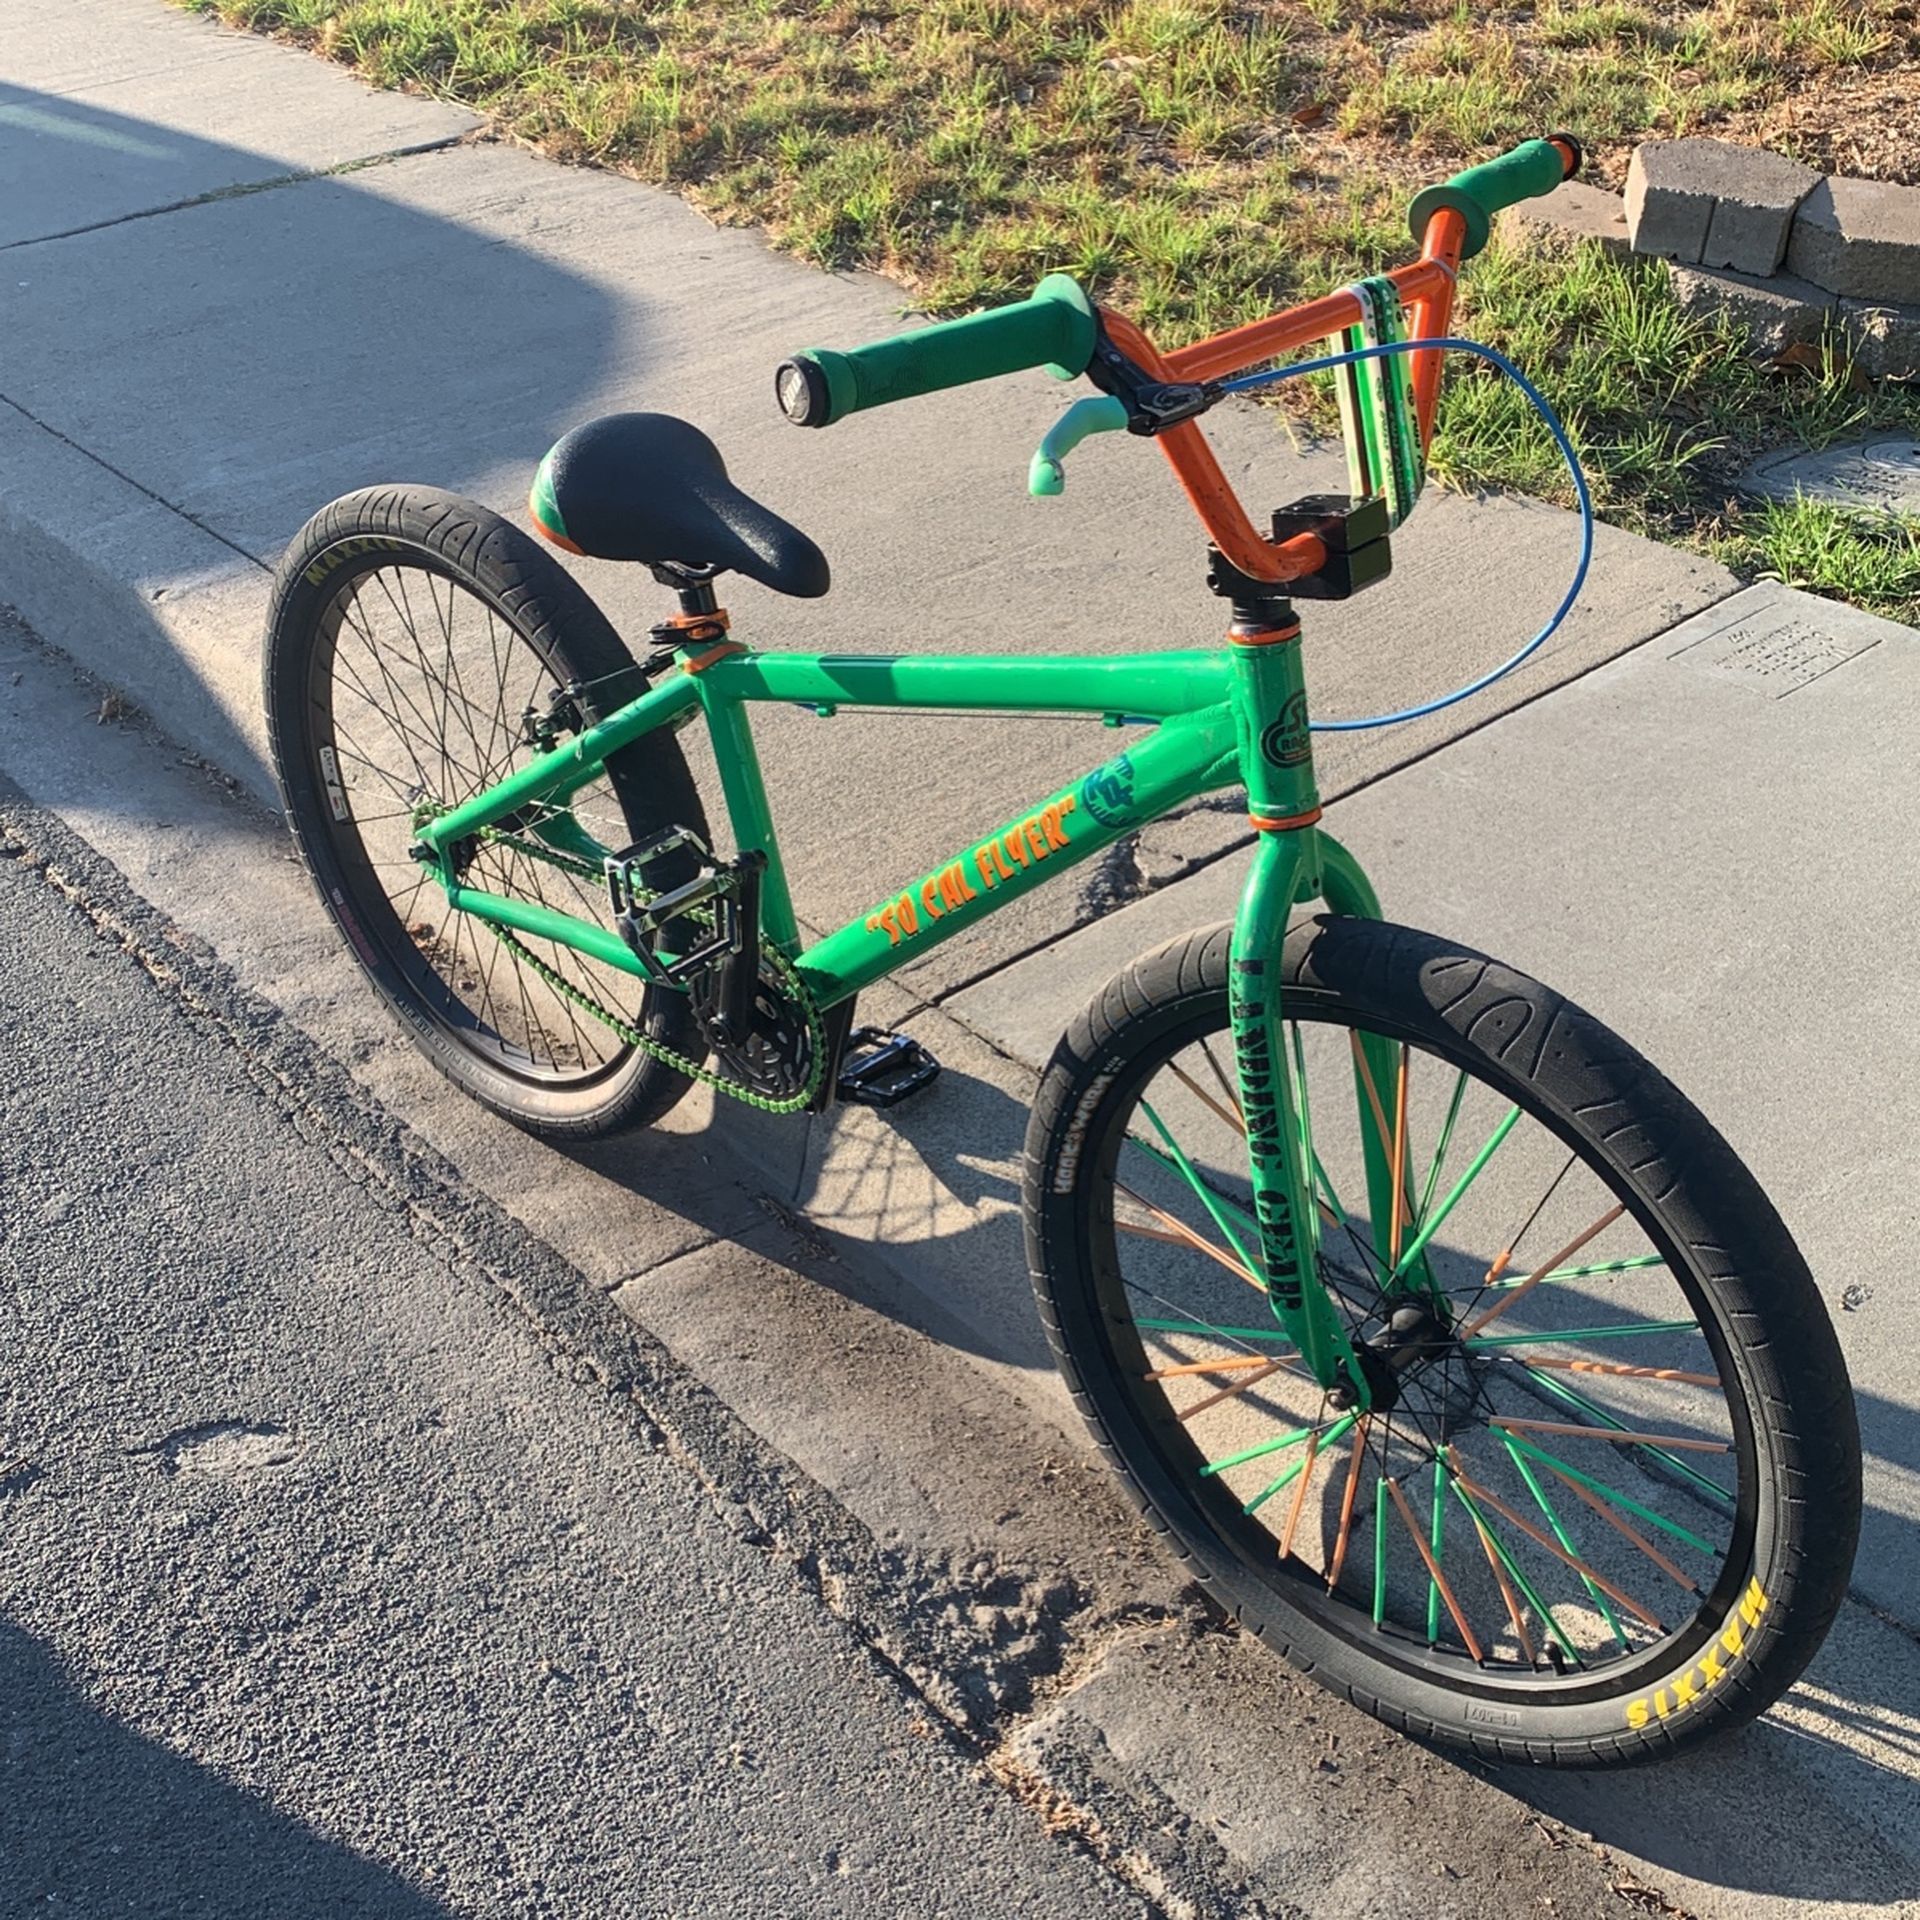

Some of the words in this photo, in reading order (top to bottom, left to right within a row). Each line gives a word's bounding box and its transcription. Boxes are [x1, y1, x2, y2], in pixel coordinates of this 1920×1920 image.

[921, 860, 977, 920] CAL
[1256, 1189, 1303, 1311] GEAR
[1625, 1575, 1769, 1730] MAXXIS
